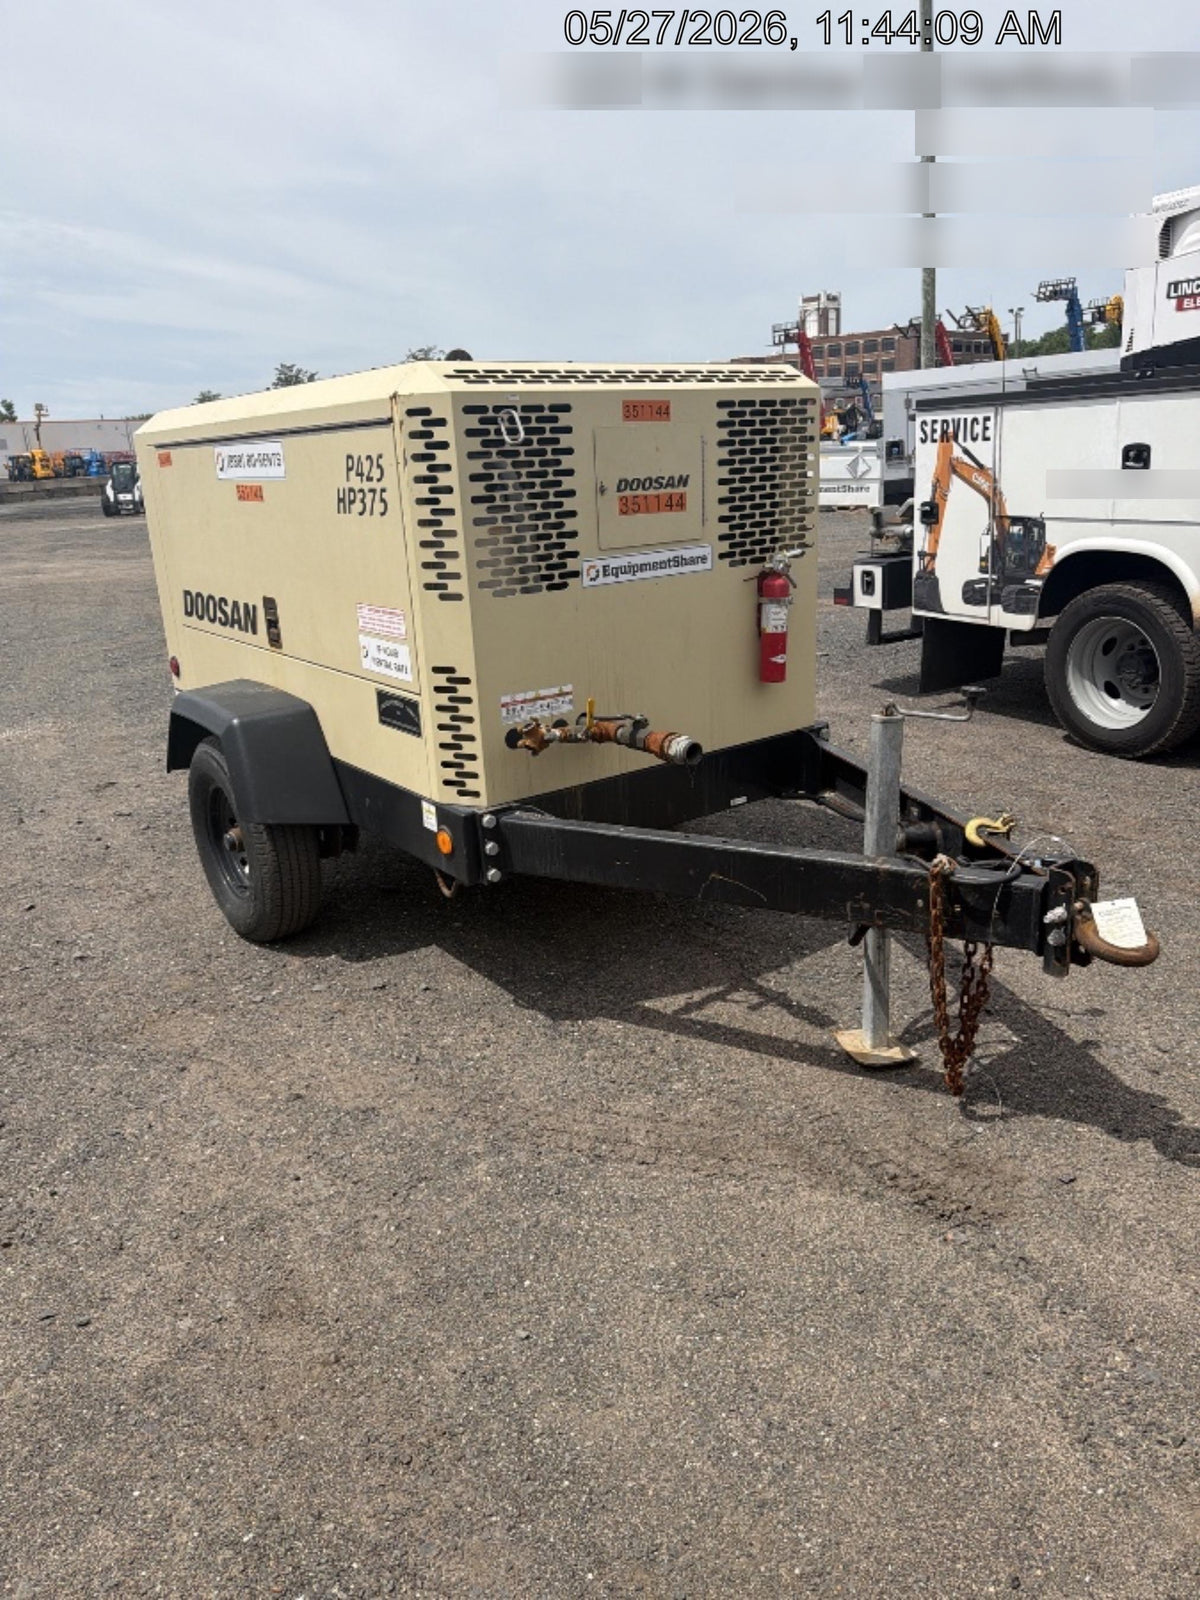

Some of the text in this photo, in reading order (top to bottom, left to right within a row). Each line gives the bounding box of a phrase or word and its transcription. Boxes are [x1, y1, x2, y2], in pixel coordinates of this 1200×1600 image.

[623, 404, 671, 419] 351144
[919, 415, 992, 445] SERVICE
[345, 453, 385, 484] P425
[616, 474, 690, 493] DOOSAN
[336, 486, 389, 517] HP375
[619, 492, 684, 515] 351144
[602, 554, 708, 579] EquipmentShare
[183, 589, 258, 636] DOOSAN
